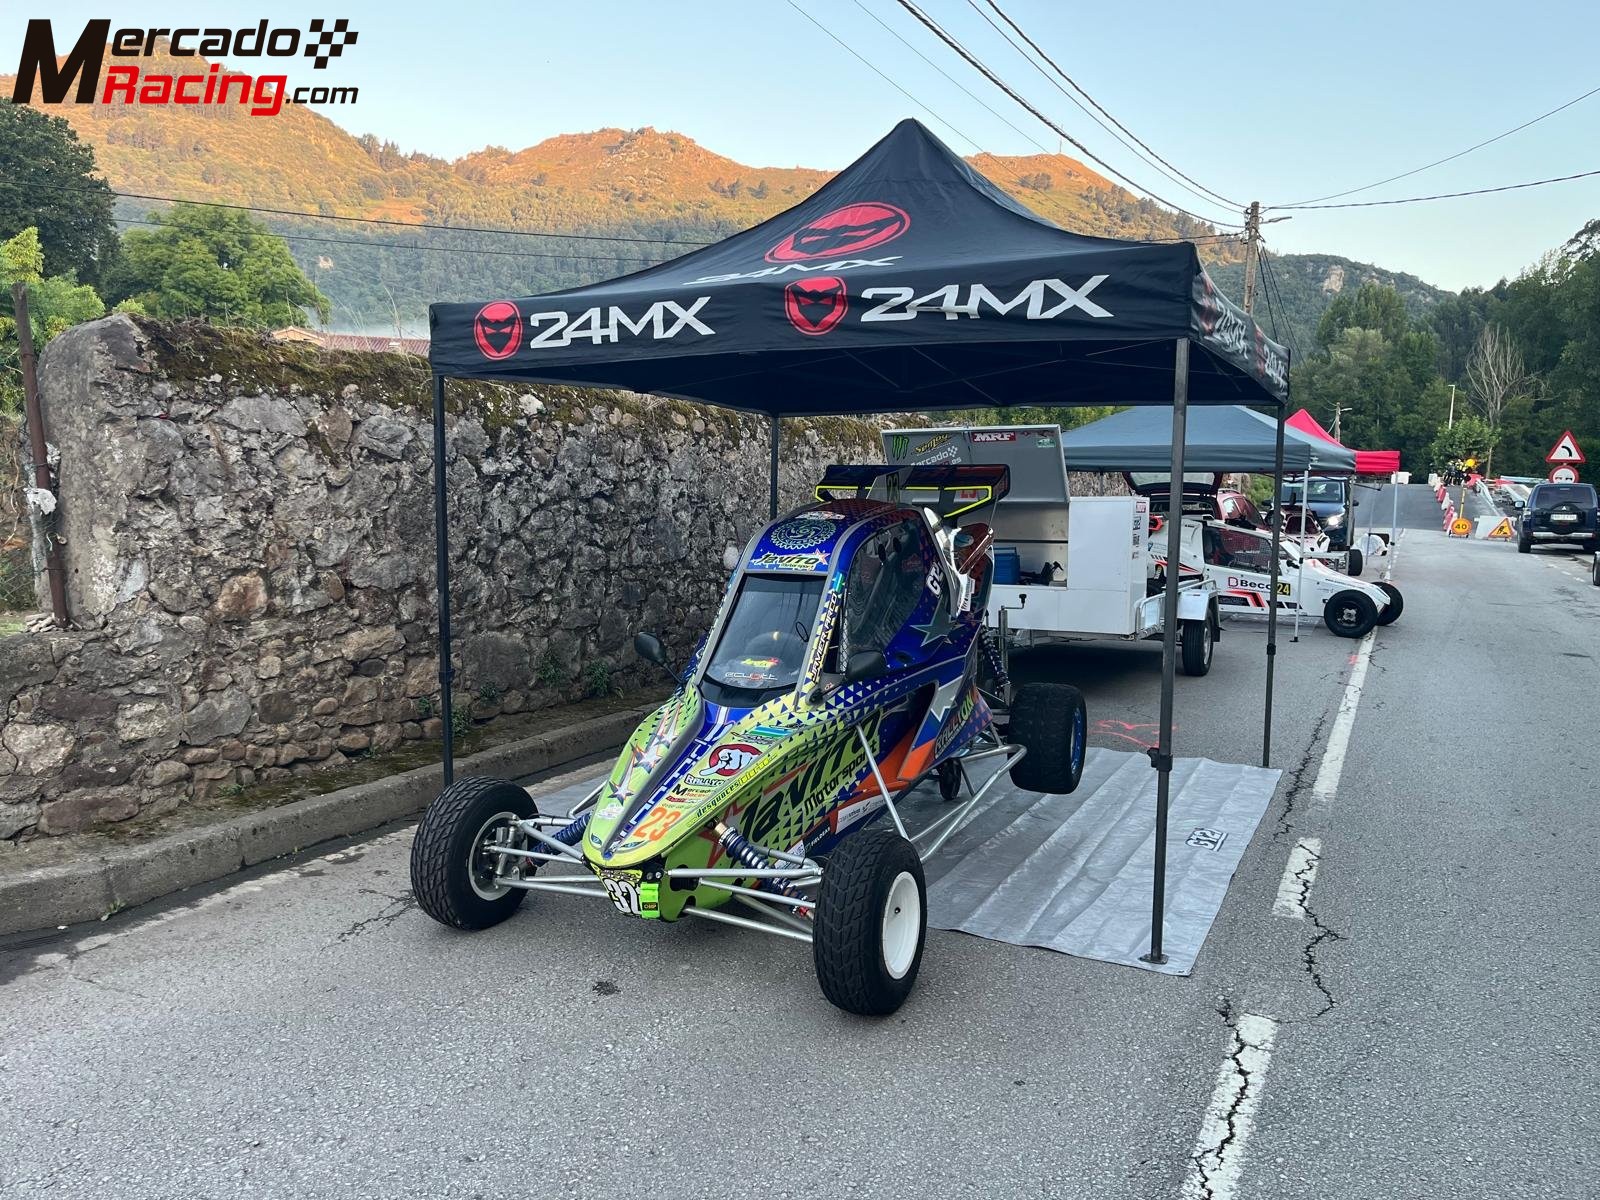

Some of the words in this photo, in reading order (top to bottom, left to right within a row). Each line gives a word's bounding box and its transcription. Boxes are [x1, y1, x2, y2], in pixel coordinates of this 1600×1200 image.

[860, 274, 1115, 322] 24MX
[529, 296, 716, 349] 24MX
[973, 432, 1012, 442] MRF
[1277, 583, 1291, 595] 24
[632, 806, 682, 842] 23
